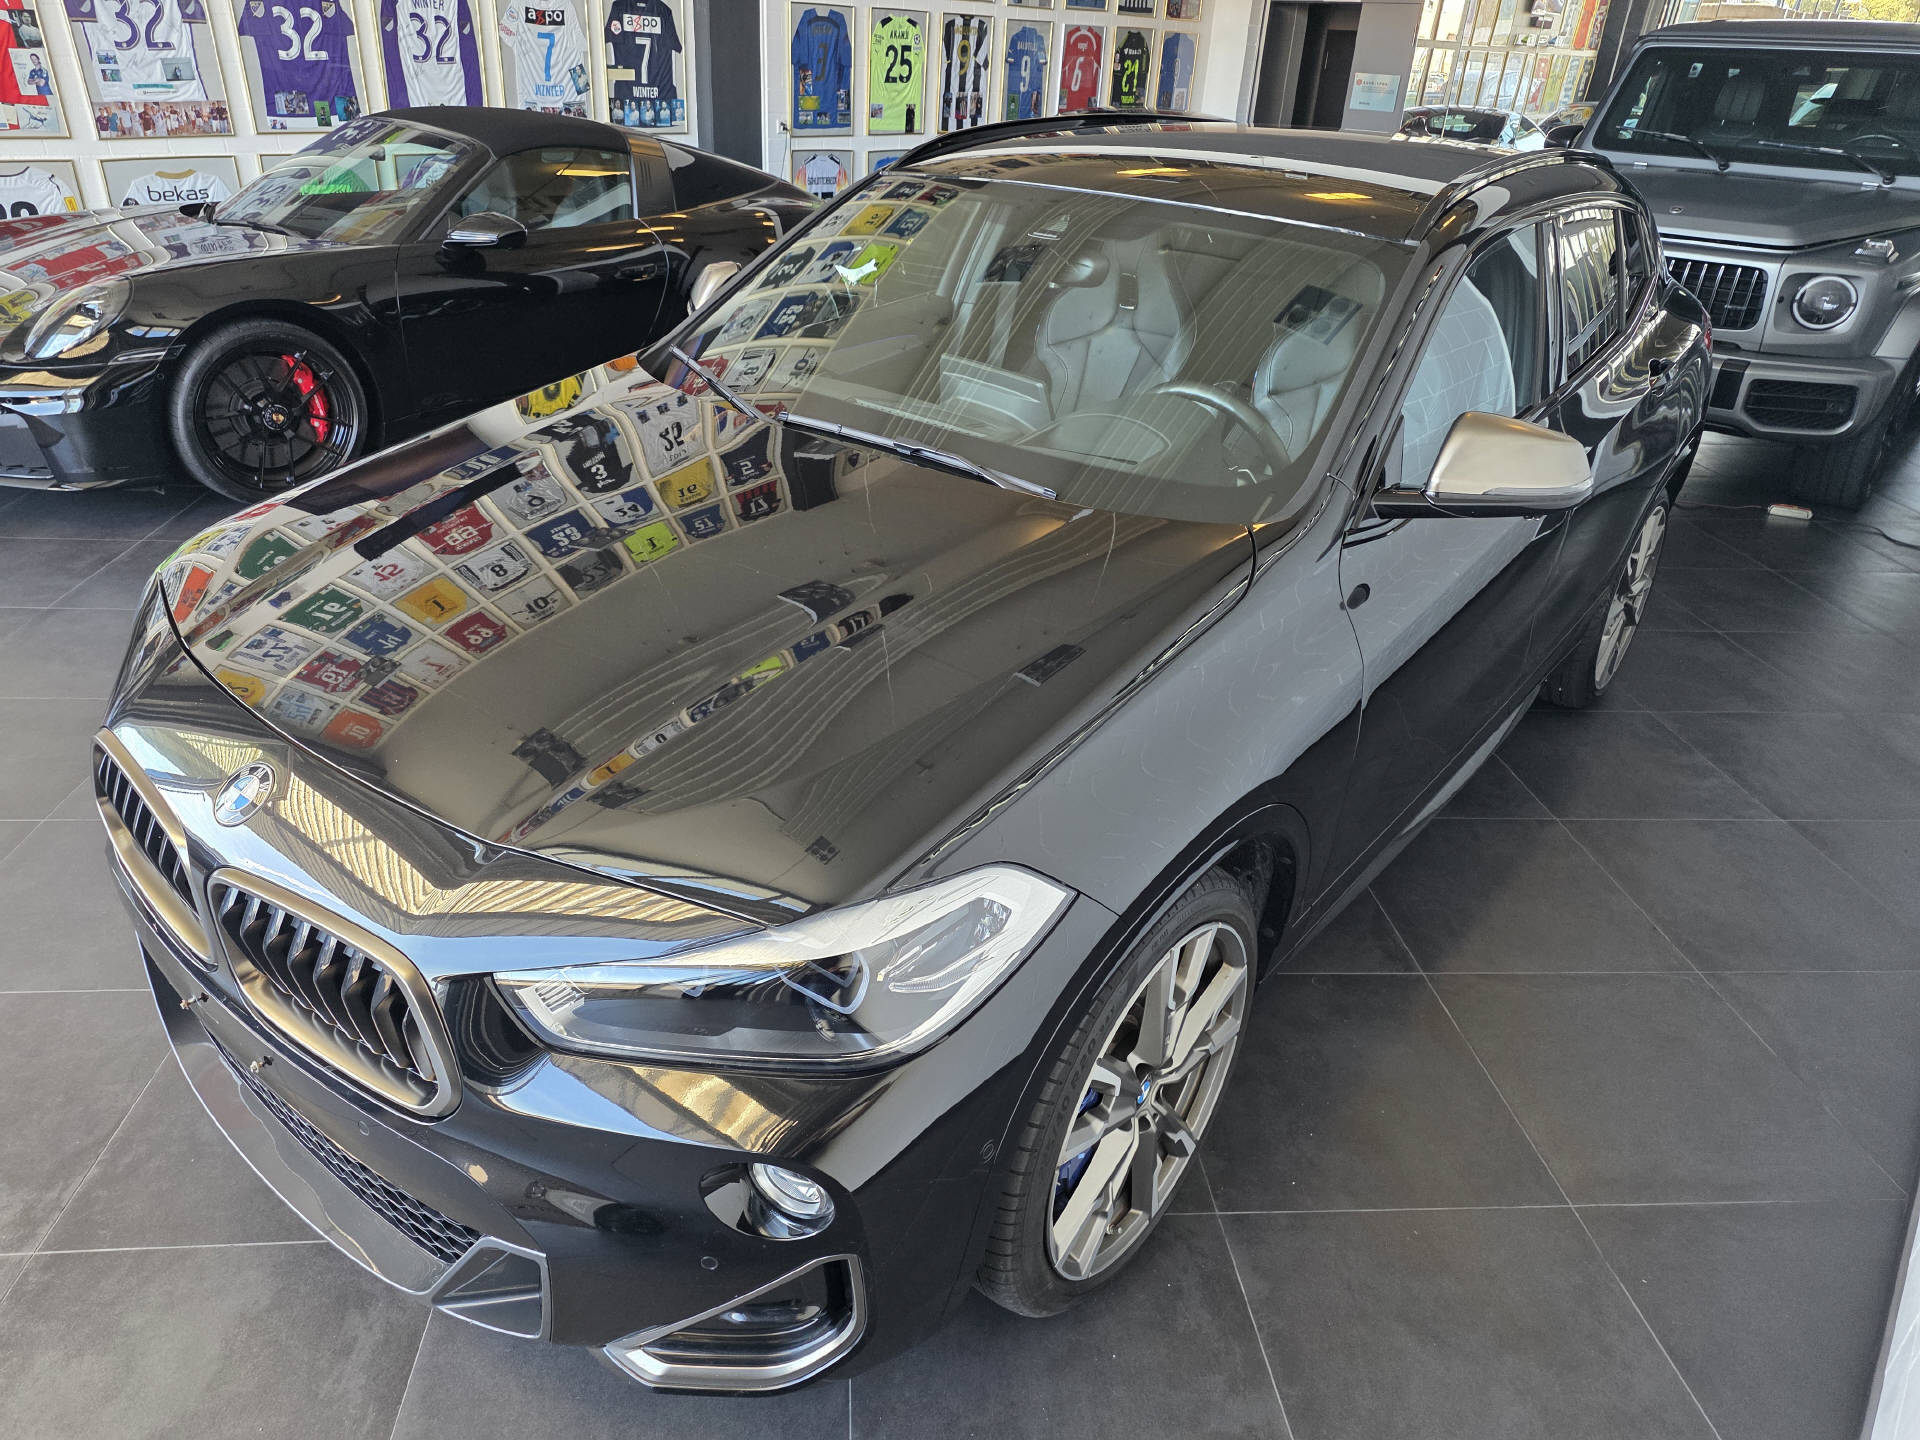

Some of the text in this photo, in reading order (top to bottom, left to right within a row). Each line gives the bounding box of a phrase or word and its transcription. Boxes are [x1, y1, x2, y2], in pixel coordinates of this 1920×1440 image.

[110, 0, 176, 51] 32
[271, 5, 329, 61] 32
[409, 12, 456, 65] 32
[536, 31, 556, 82] 7
[635, 36, 652, 85] 7
[884, 44, 913, 84] 25
[957, 39, 972, 76] 9
[1019, 55, 1031, 93] 9
[1071, 56, 1085, 92] 6
[534, 83, 565, 97] WINTER
[632, 85, 659, 99] WINTER
[1122, 59, 1140, 93] 21
[146, 185, 210, 202] bekas
